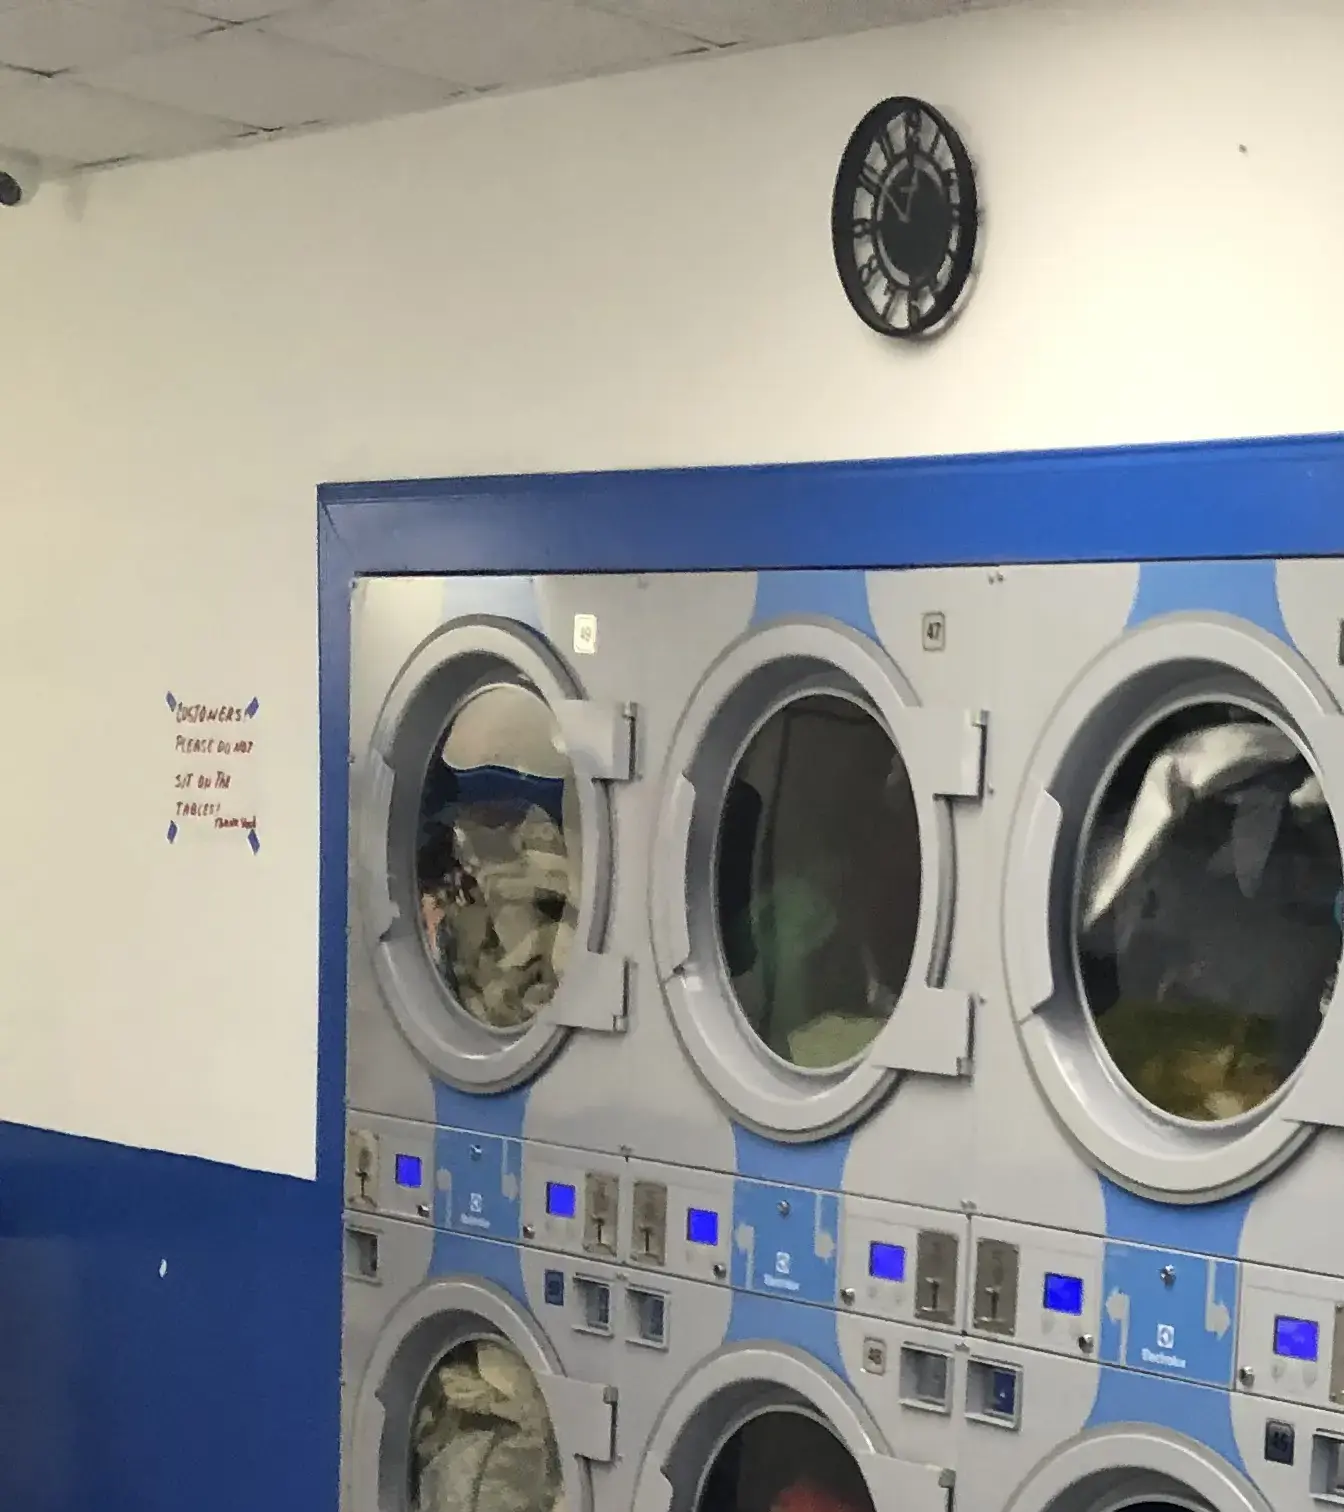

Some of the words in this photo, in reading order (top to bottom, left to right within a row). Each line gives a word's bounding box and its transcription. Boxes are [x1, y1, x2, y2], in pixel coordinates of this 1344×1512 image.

[926, 621, 942, 640] 47
[176, 735, 214, 753] PLEASE
[217, 740, 231, 755] DO
[175, 773, 194, 789] SIT
